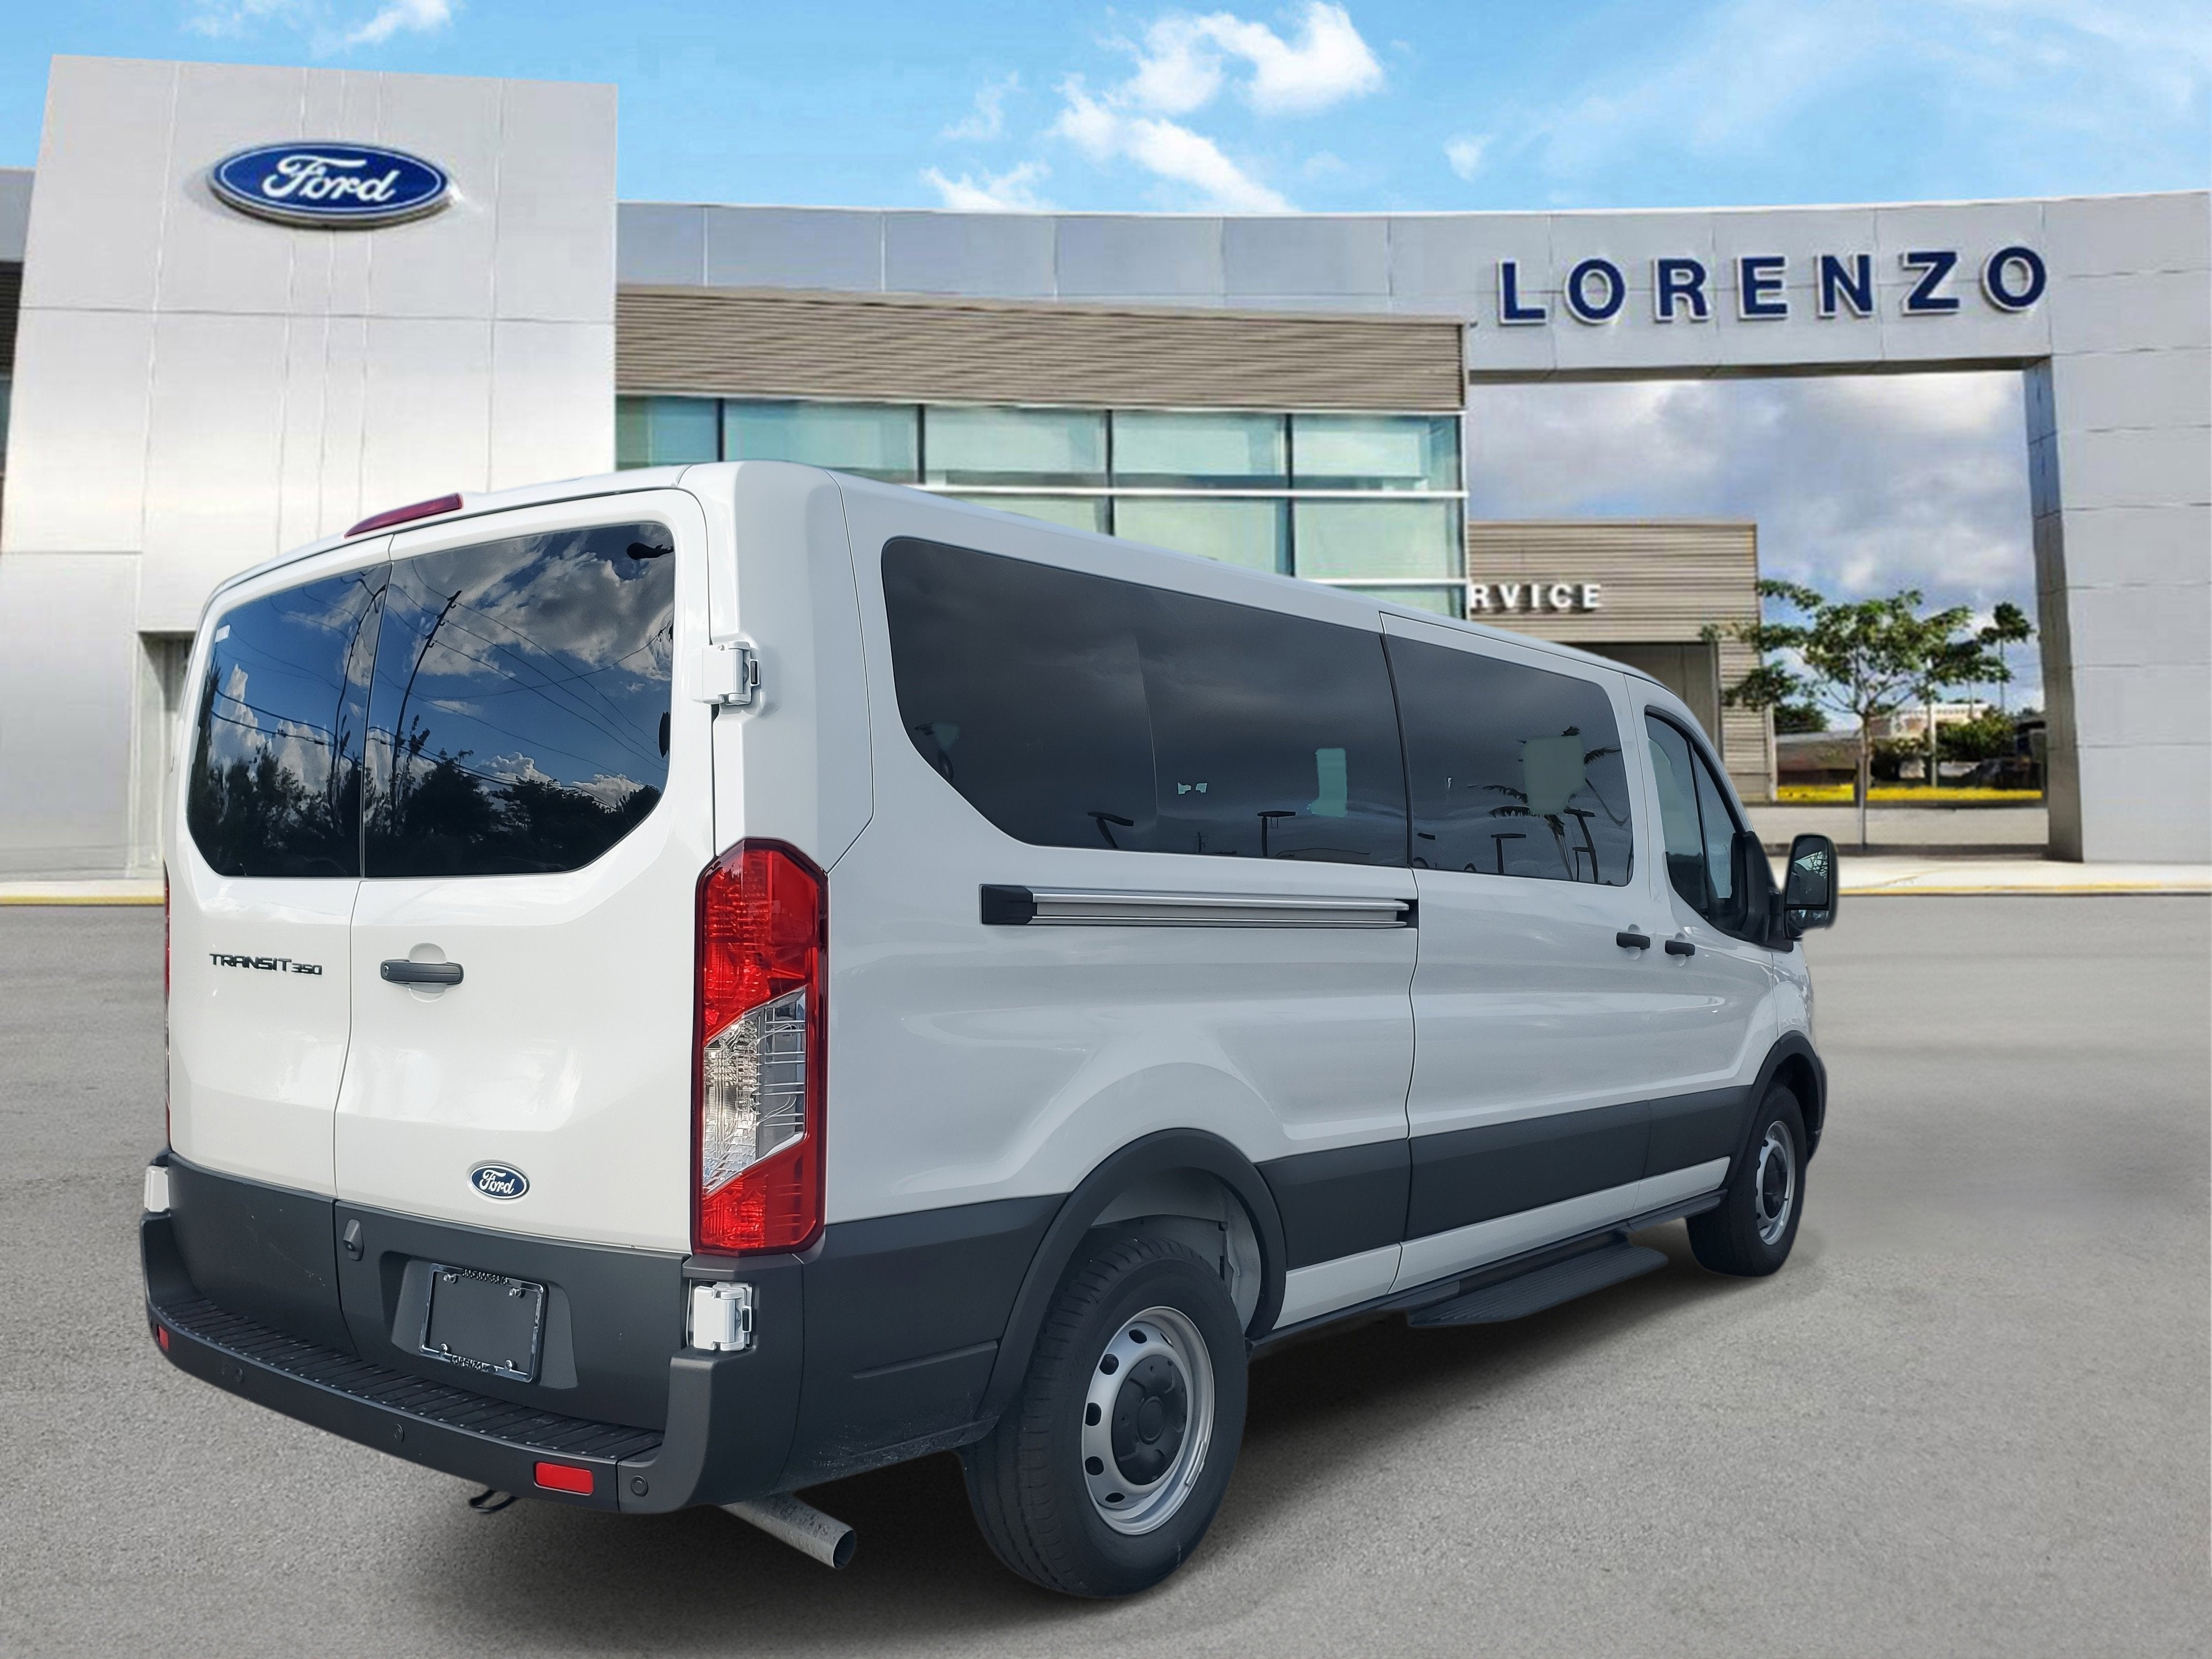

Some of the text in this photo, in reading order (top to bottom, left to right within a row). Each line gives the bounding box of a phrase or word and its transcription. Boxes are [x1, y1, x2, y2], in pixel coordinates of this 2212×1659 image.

[262, 154, 400, 201] Ford
[1497, 245, 2048, 325] LORENZO
[1470, 583, 1602, 609] RVICE
[209, 953, 292, 971] TRANSIT
[479, 1169, 516, 1194] Ford
